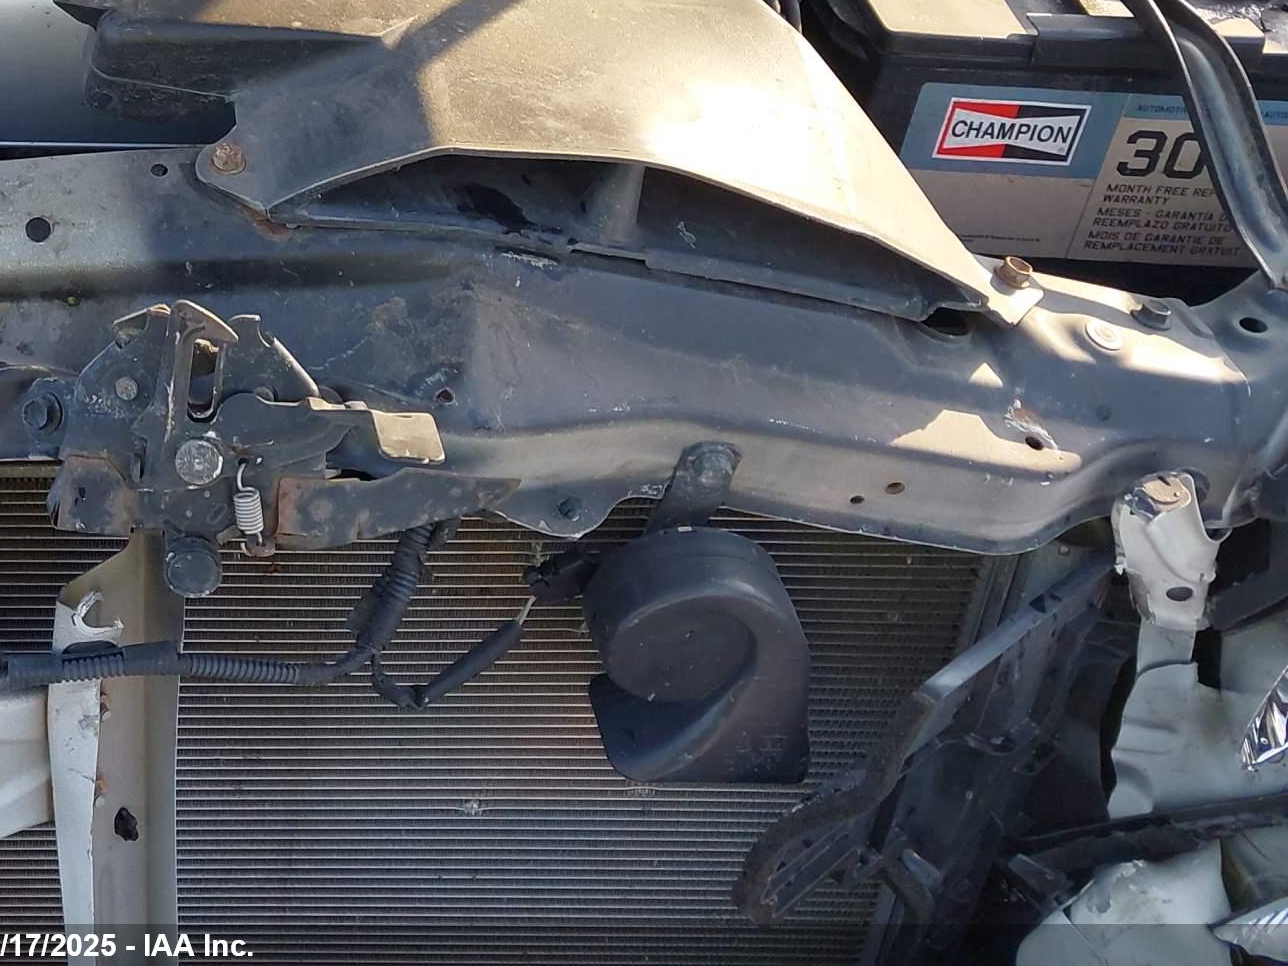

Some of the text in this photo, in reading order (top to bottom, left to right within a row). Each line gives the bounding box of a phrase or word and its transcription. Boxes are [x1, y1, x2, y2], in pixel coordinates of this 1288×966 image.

[951, 119, 1072, 144] CHAMPION
[1116, 129, 1206, 180] 30
[1106, 183, 1152, 195] MONTH
[1155, 186, 1187, 196] FREE
[1103, 194, 1170, 205] WARRANTY
[1097, 207, 1142, 218] MESES
[1092, 217, 1169, 230] REEMPLAZO
[1087, 230, 1224, 245] MOIS DE GARANTIE DE
[1084, 241, 1241, 256] REMPLACEMENT GRATUIT
